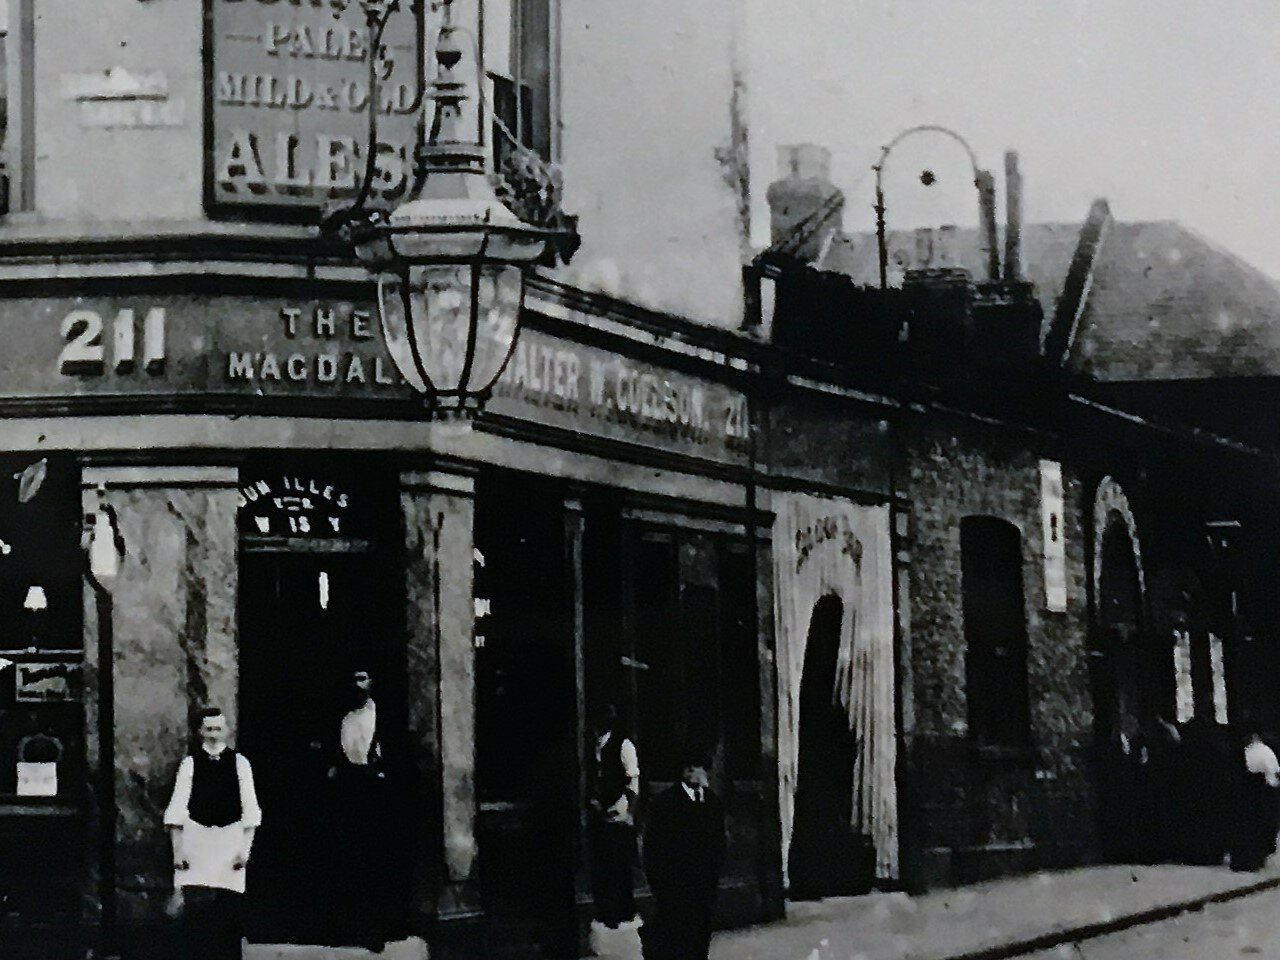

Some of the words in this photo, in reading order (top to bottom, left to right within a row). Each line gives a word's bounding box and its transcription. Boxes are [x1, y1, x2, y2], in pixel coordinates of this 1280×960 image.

[218, 131, 410, 200] ALES
[60, 307, 166, 374] 211
[281, 306, 375, 338] THE
[228, 351, 408, 385] MAGDAL
